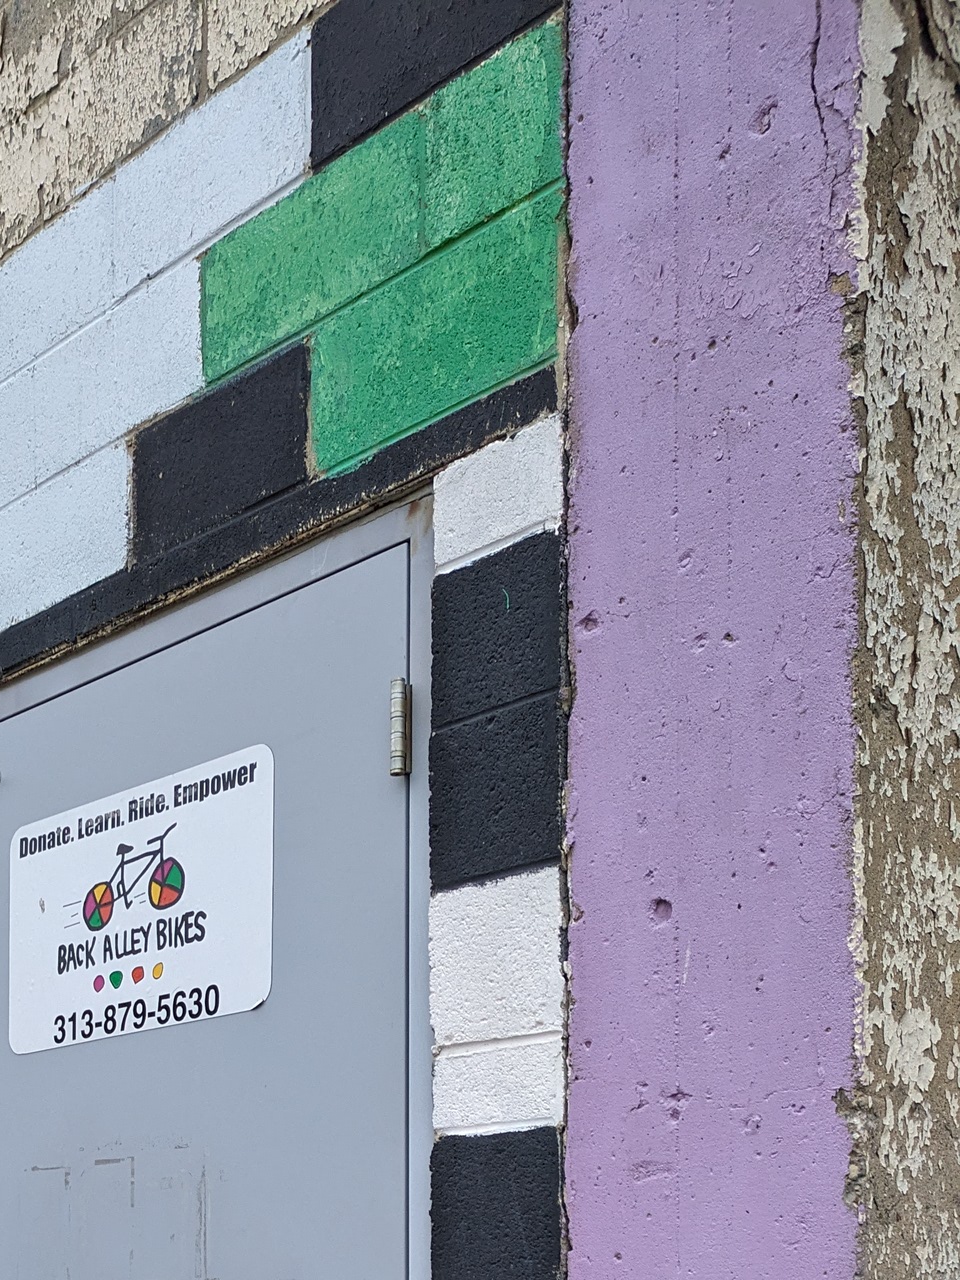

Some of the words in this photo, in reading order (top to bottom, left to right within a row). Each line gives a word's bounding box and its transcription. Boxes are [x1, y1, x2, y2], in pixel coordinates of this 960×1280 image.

[19, 825, 74, 859] Donate.
[78, 809, 124, 840] Learn.
[128, 793, 169, 823] Ride.
[173, 761, 257, 808] Empower
[57, 936, 96, 975] BACK
[103, 922, 152, 963] ALLEY
[156, 910, 207, 951] BIKES
[53, 984, 220, 1044] 313-879-5630
